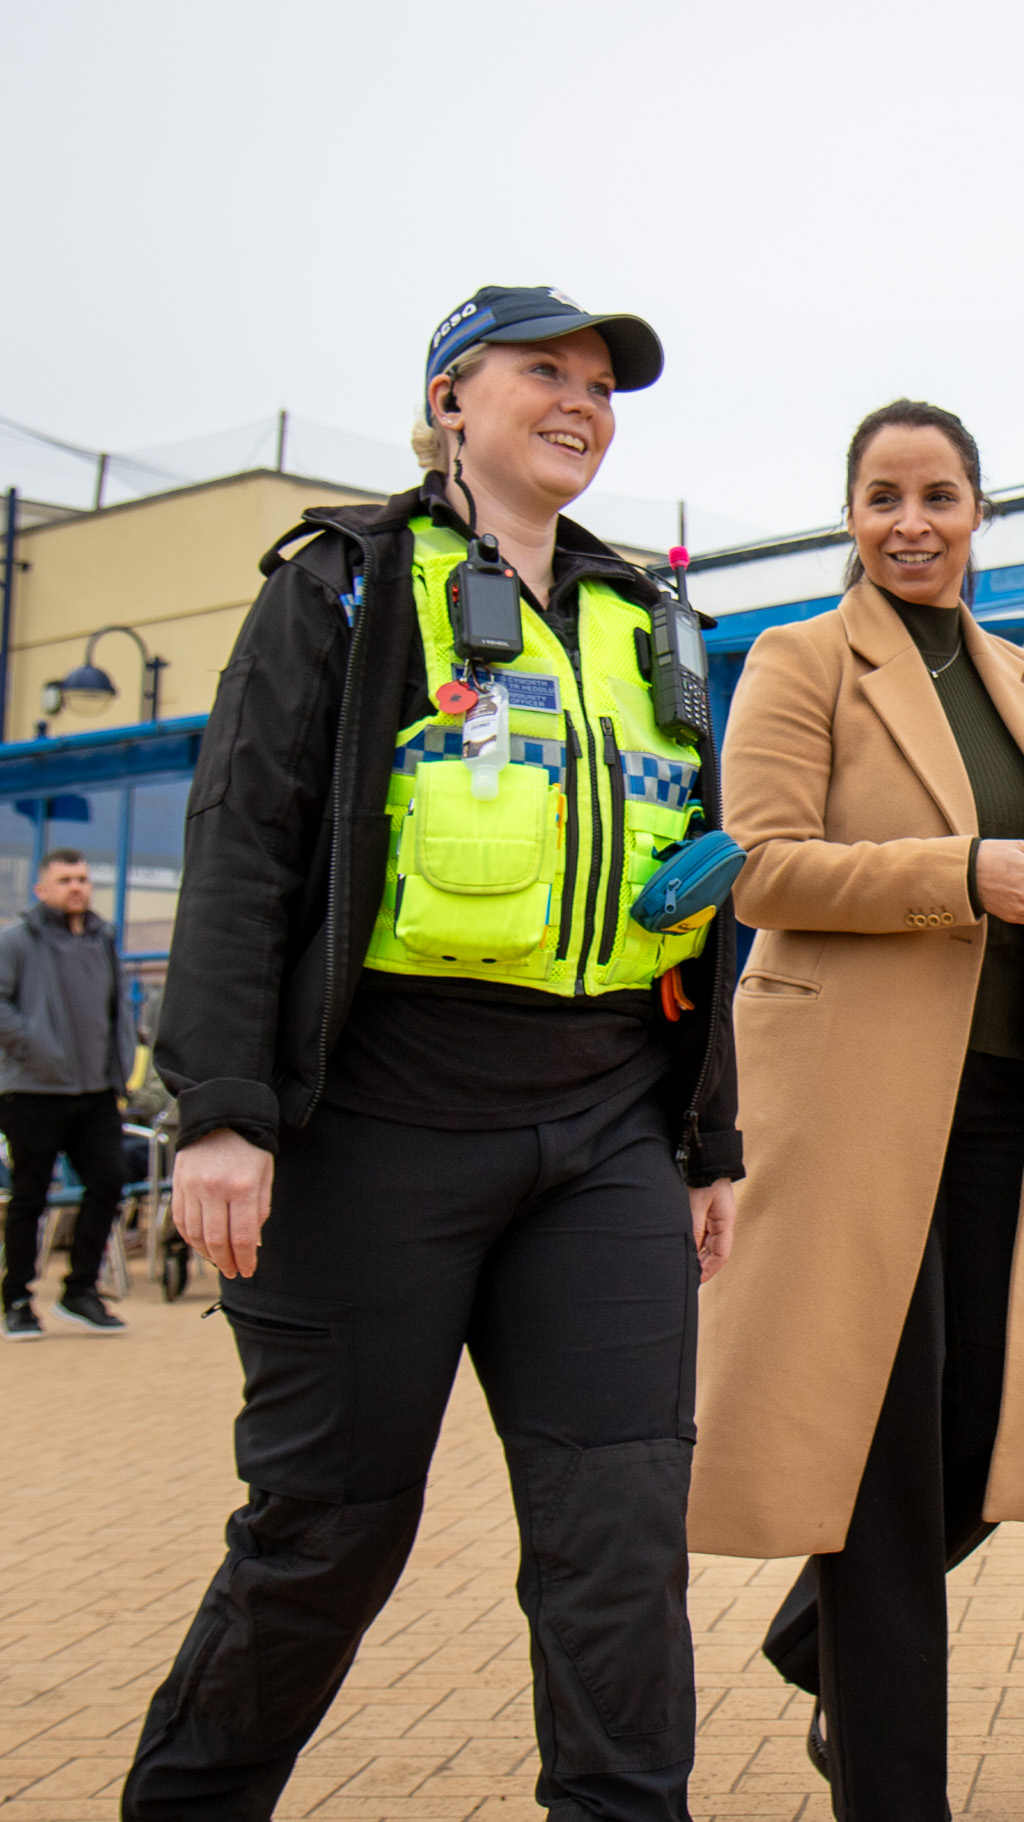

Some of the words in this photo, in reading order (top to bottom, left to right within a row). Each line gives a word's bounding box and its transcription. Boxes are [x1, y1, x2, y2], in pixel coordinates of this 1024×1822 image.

[432, 302, 477, 349] PCSO
[509, 692, 548, 702] OMMUNITY
[509, 698, 546, 708] OFFICER
